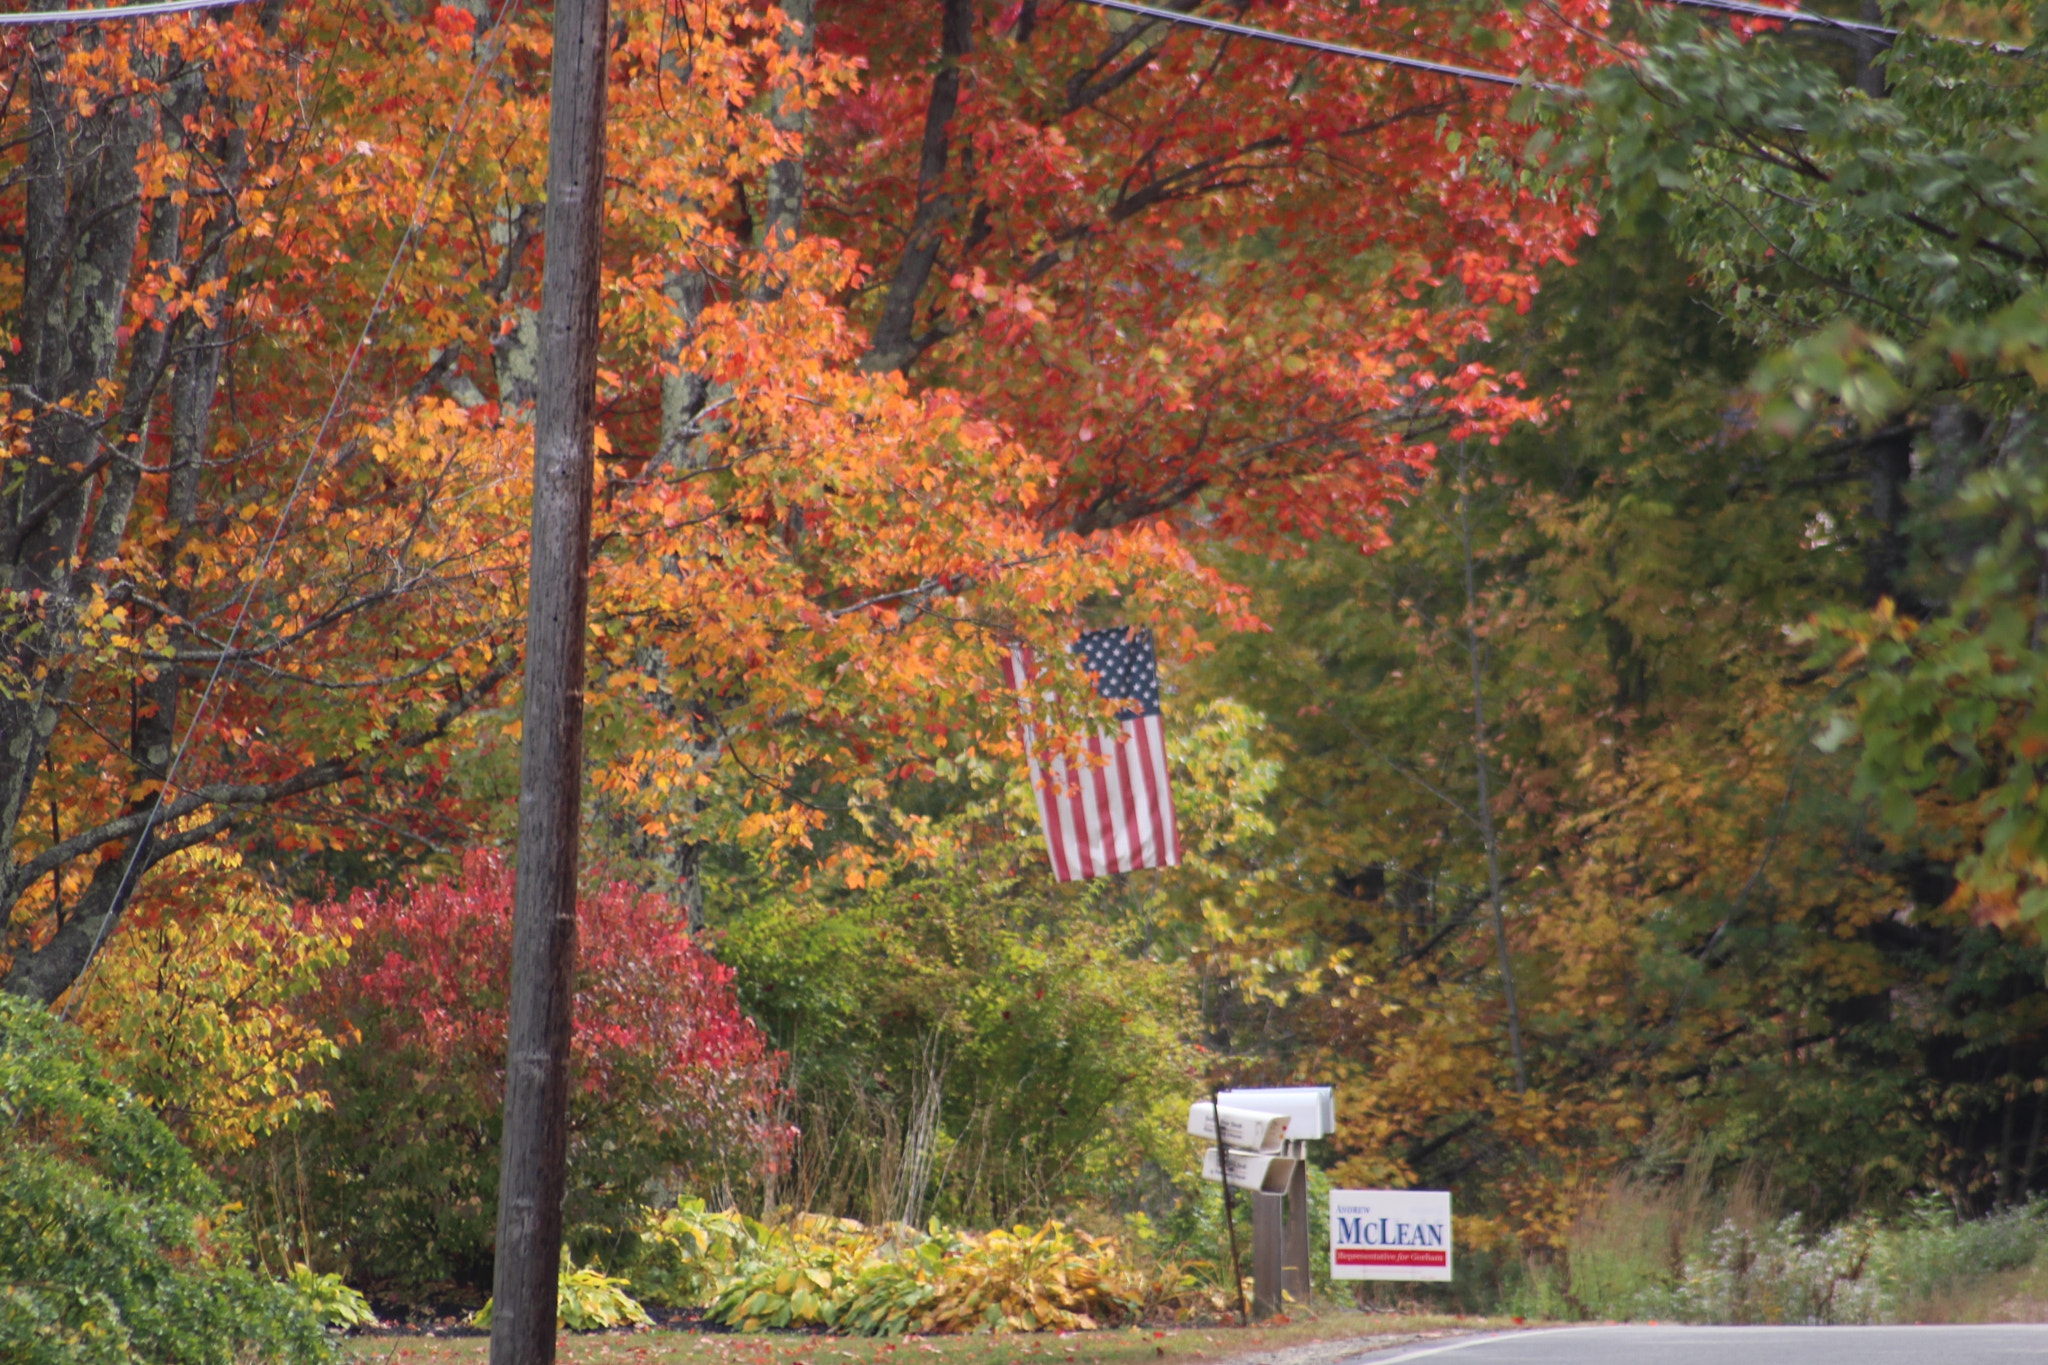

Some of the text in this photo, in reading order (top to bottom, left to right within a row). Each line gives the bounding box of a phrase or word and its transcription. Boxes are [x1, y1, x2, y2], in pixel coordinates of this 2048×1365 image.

[1336, 1205, 1370, 1214] ANDREW
[1337, 1251, 1396, 1262] Representative
[1397, 1252, 1409, 1262] for
